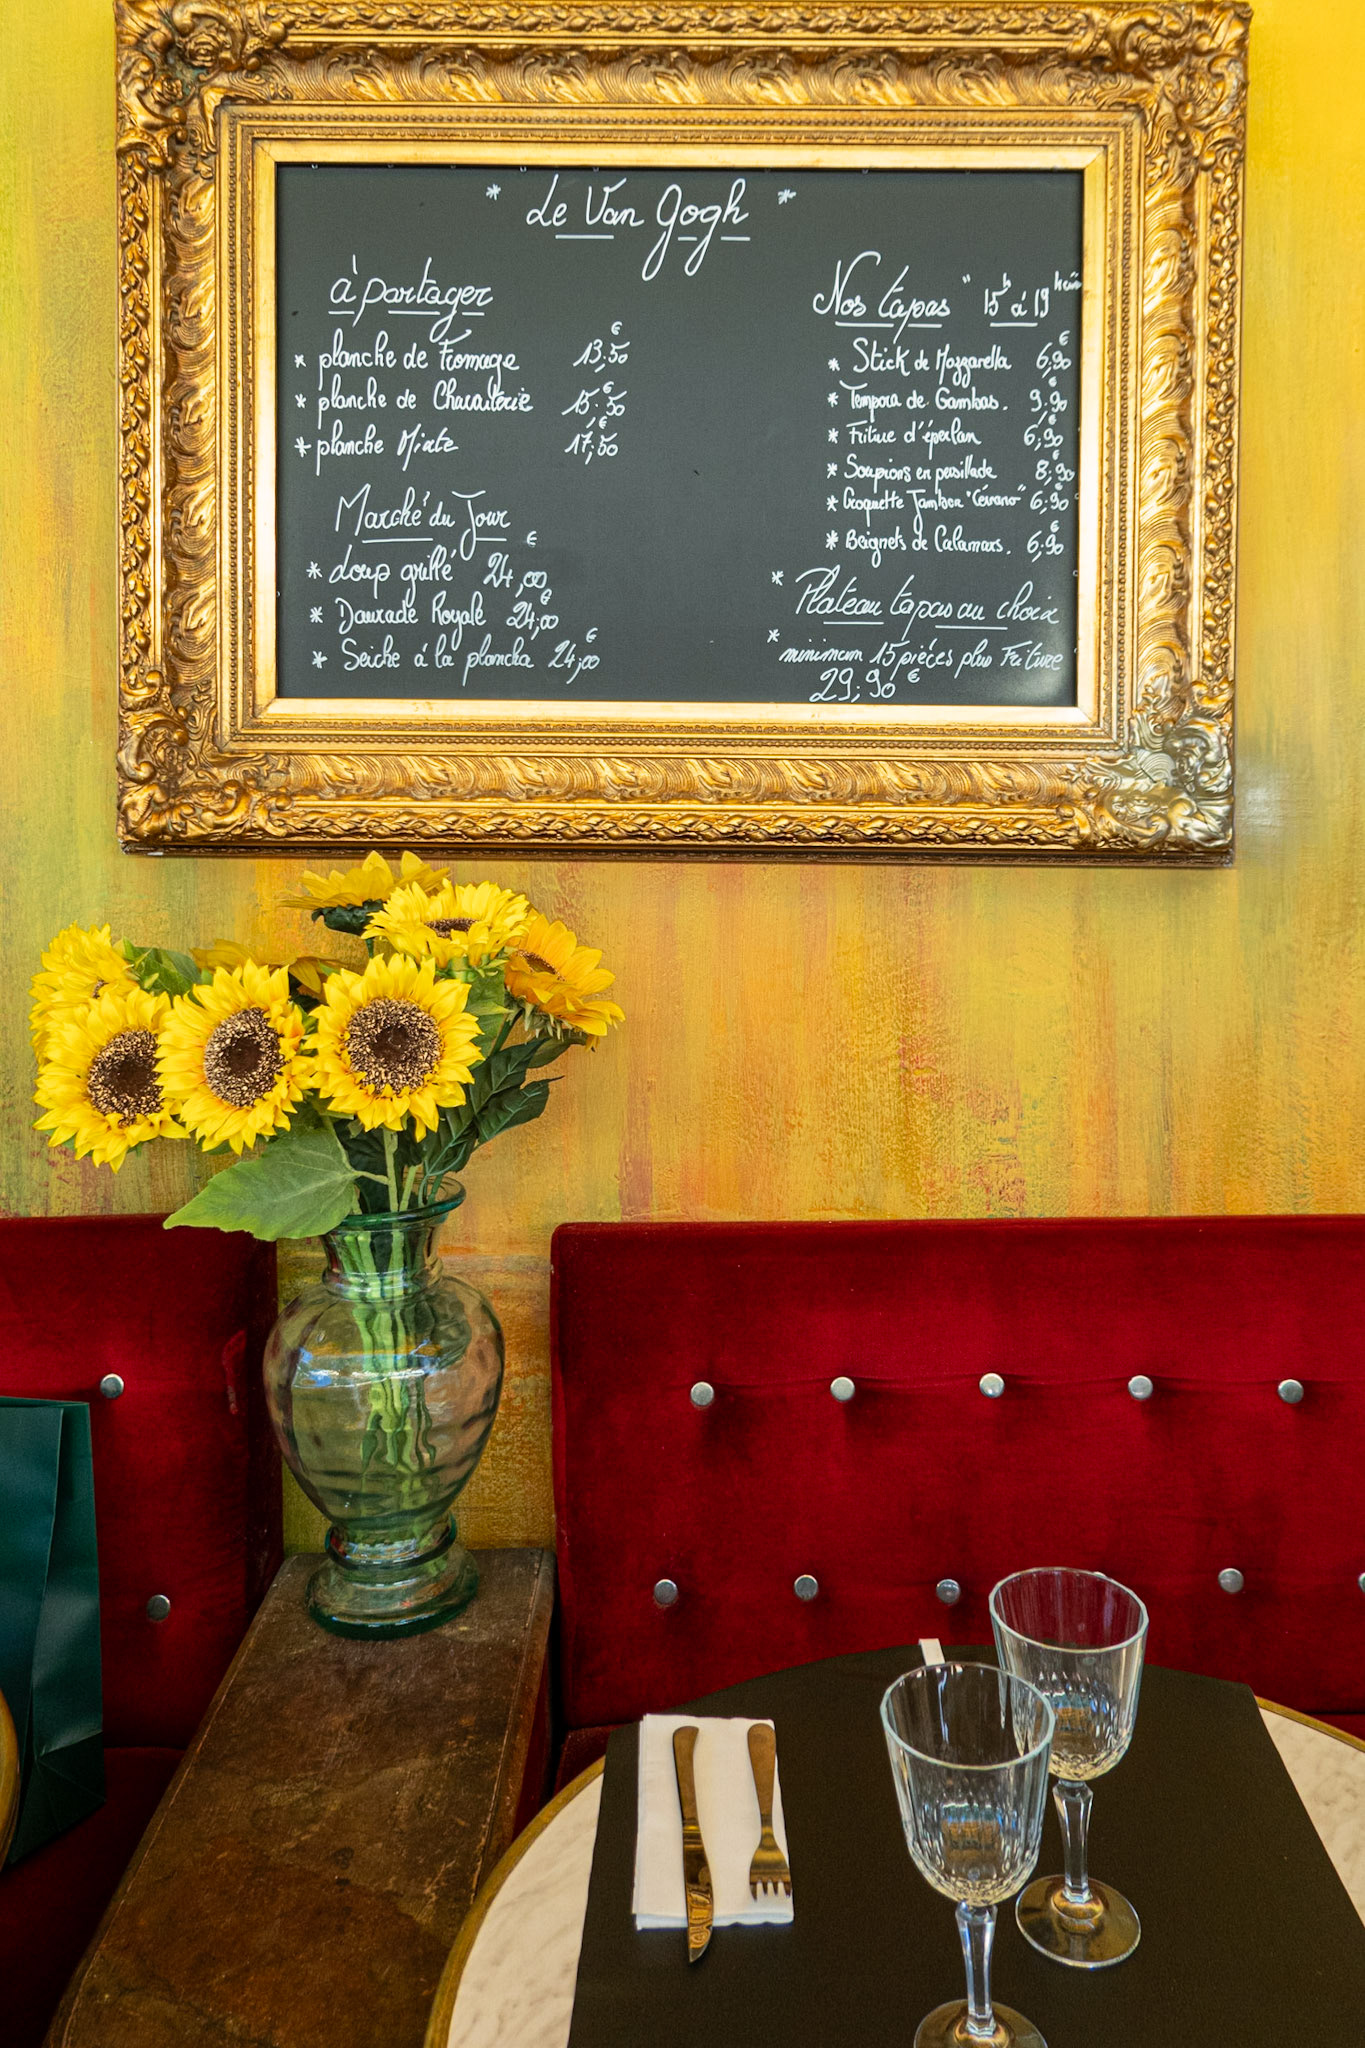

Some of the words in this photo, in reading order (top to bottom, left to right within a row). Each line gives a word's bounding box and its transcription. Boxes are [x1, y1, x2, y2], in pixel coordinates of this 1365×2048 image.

[526, 173, 568, 227] Le
[585, 177, 645, 226] Van
[642, 178, 750, 282] Gogh
[352, 256, 494, 344] partager
[812, 250, 882, 318] Nos
[877, 265, 952, 344] tapas
[318, 327, 397, 392] planche
[403, 342, 429, 370] de
[438, 328, 521, 392] Fromage
[852, 336, 911, 377] Stick
[914, 348, 931, 372] de
[935, 342, 1013, 389] Mozzarella
[317, 373, 388, 431] planche
[396, 388, 418, 410] de
[906, 388, 927, 410] de
[316, 418, 385, 477] planche
[845, 419, 897, 446] Friture
[916, 465, 932, 481] en
[335, 482, 431, 537] Marché
[428, 500, 456, 528] du
[451, 489, 512, 562] Jour
[842, 486, 905, 528] Croquette
[845, 525, 907, 569] Beignets
[911, 532, 929, 551] de
[400, 544, 458, 609] grillé
[795, 563, 883, 617] Plateau
[889, 574, 954, 642] tapas
[957, 601, 986, 621] au
[996, 580, 1060, 625] choix
[334, 596, 419, 635] Daurade
[431, 590, 487, 652] Royale
[341, 634, 401, 672] Seiche
[435, 632, 455, 669] la
[462, 632, 535, 687] plancha
[869, 640, 911, 668] 15
[953, 637, 993, 680] plus
